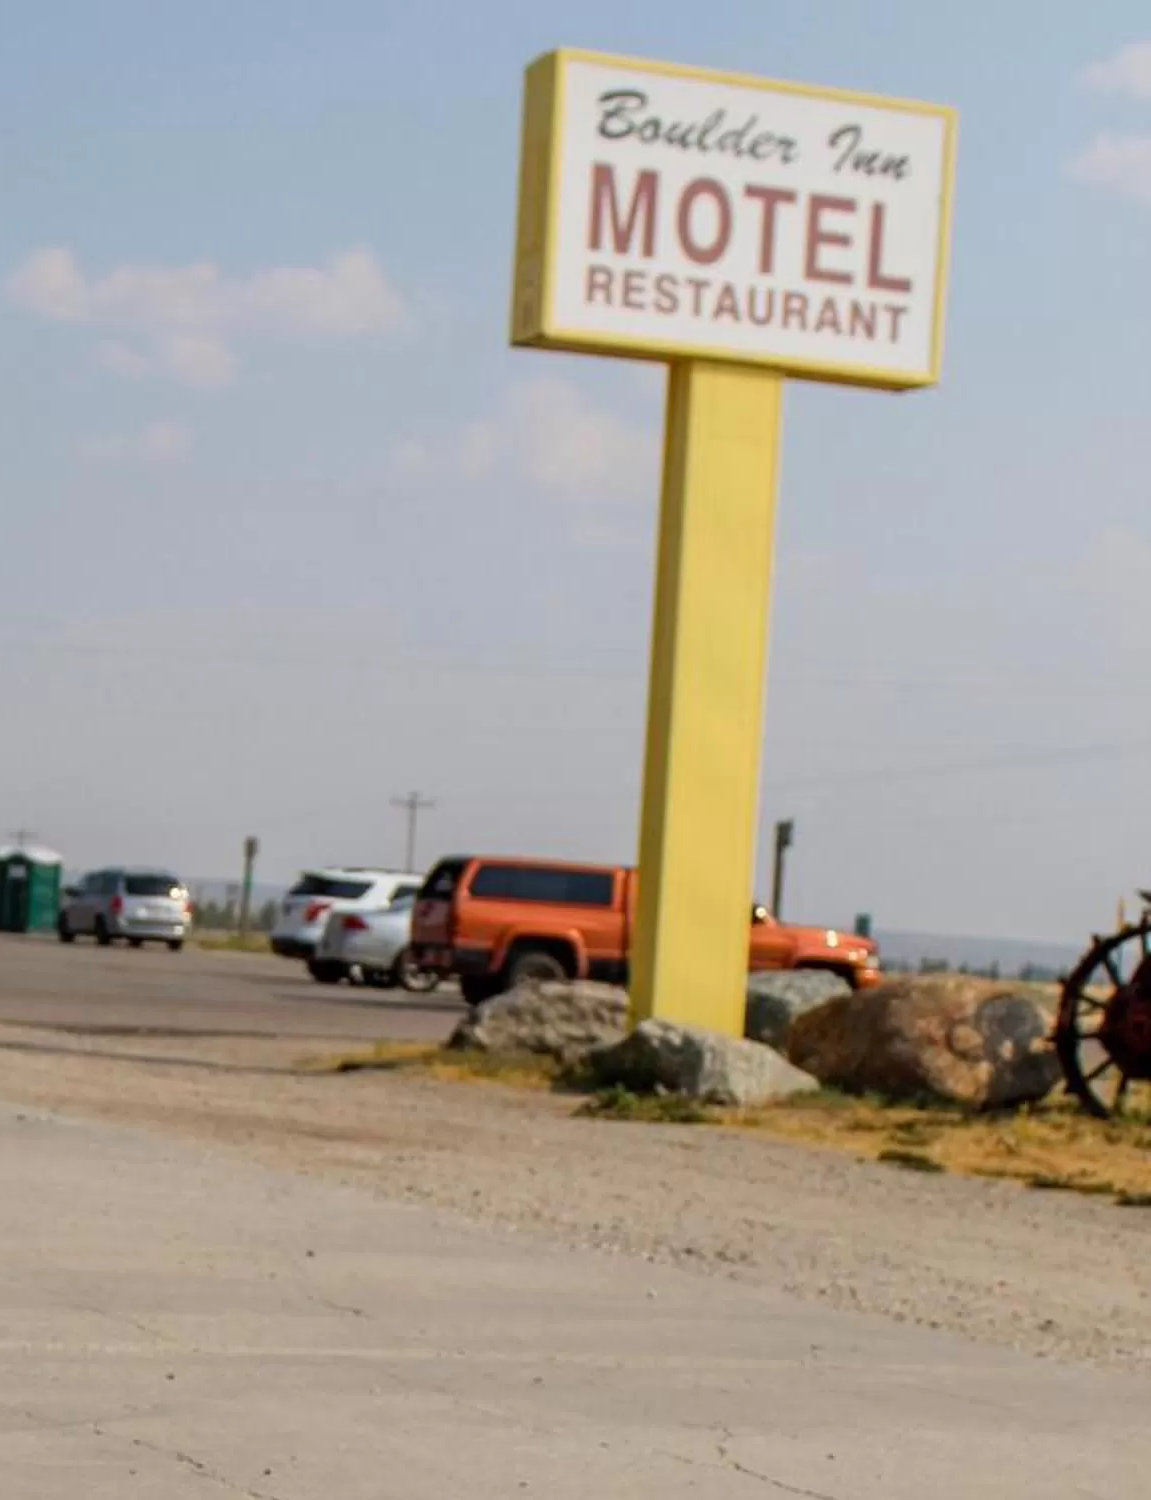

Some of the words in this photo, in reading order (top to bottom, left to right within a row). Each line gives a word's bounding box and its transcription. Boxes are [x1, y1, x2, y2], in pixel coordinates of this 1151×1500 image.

[595, 89, 801, 163] Boulder
[827, 124, 912, 180] Inn
[587, 162, 913, 293] MOTEL
[584, 265, 910, 343] RESTAURANT
